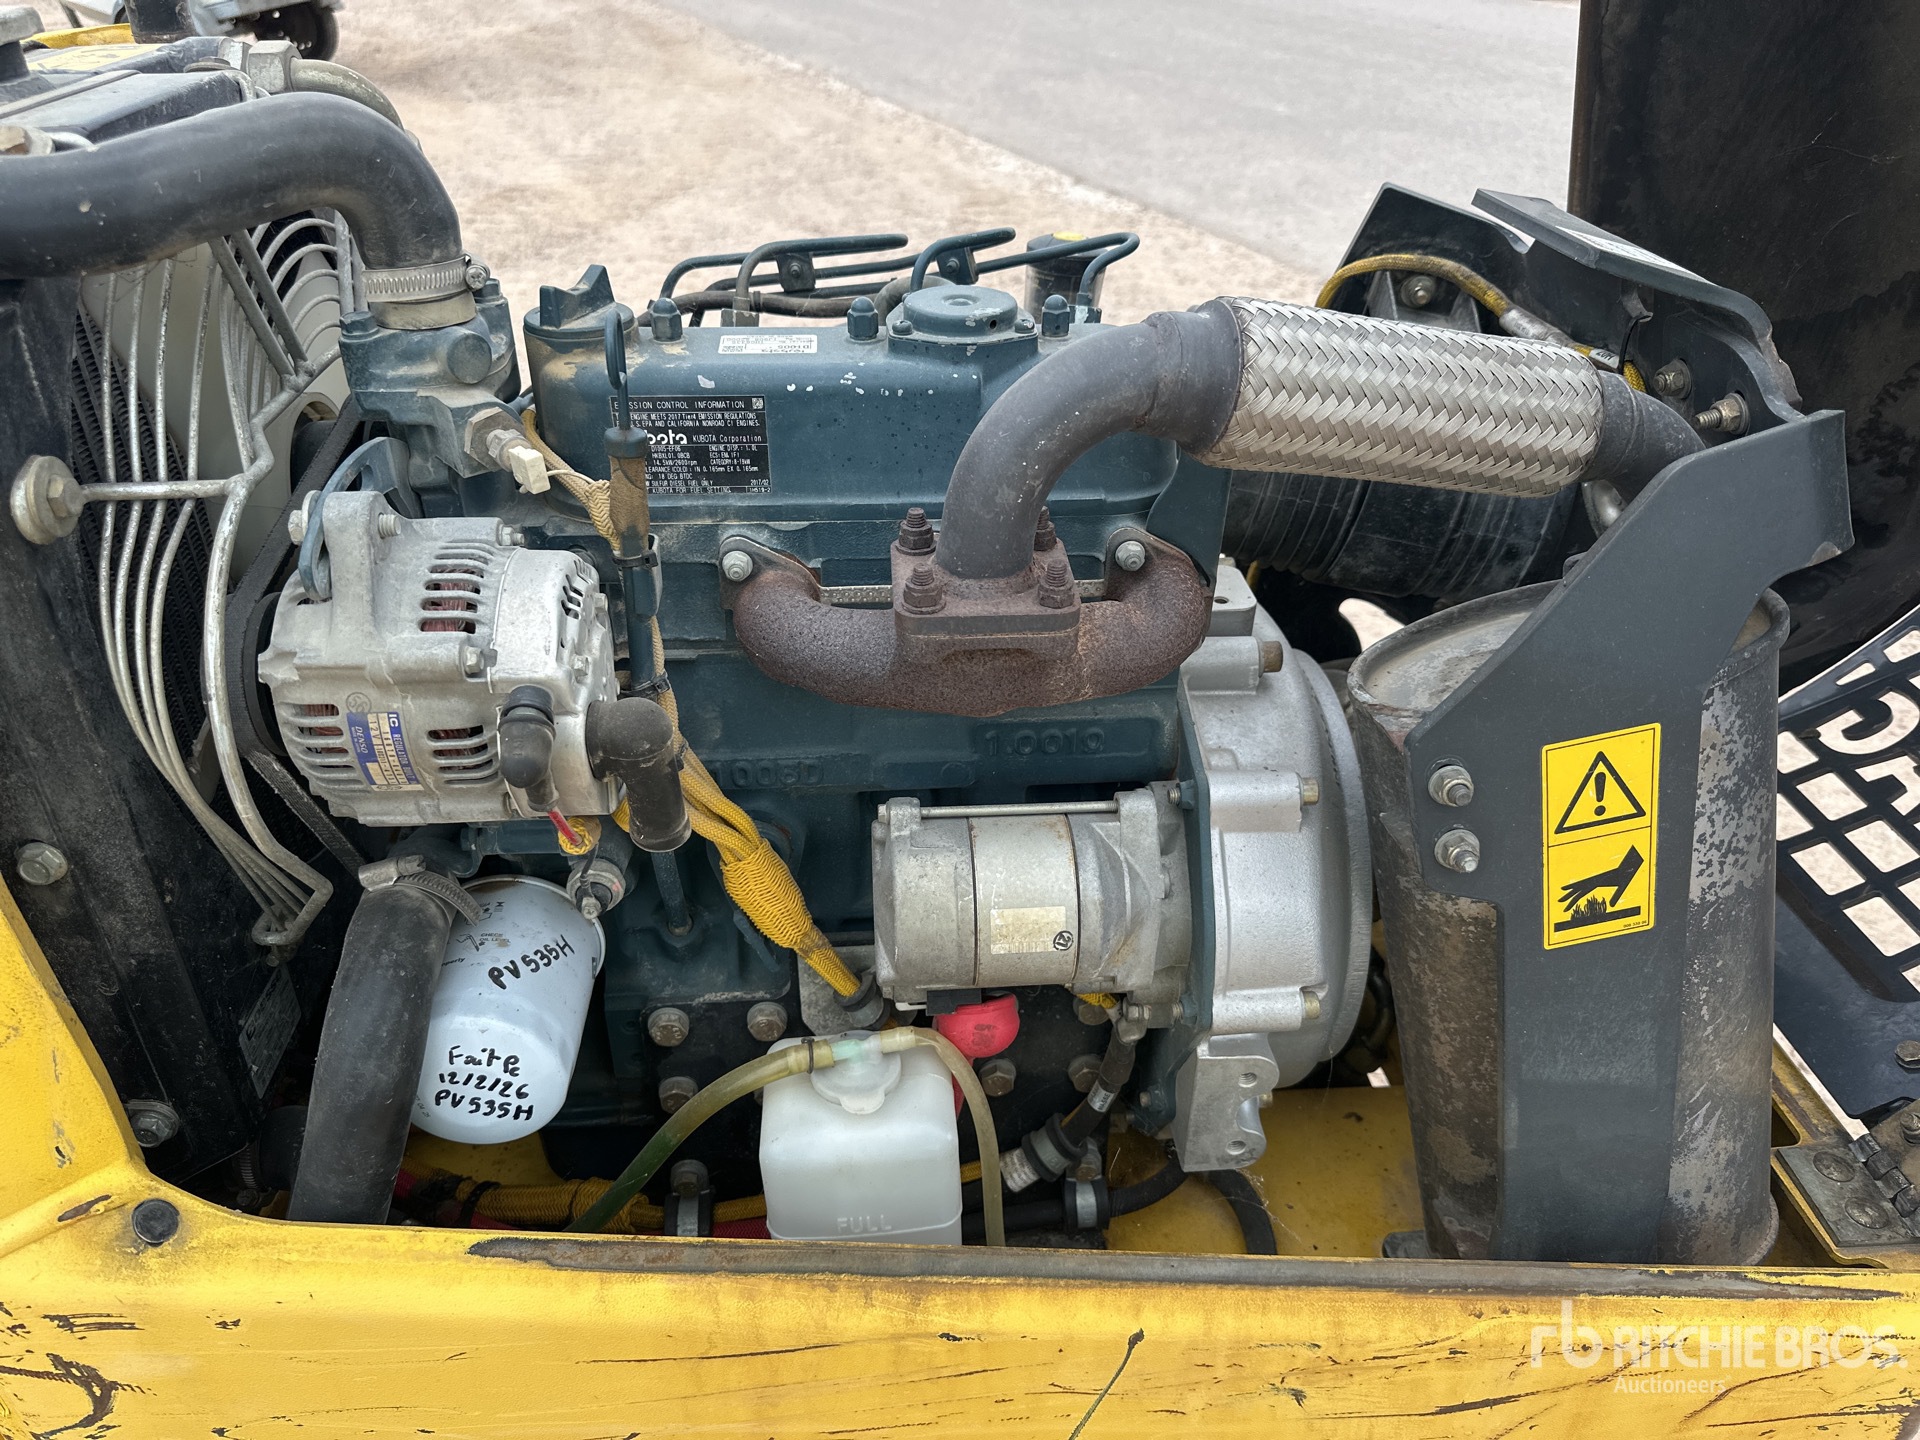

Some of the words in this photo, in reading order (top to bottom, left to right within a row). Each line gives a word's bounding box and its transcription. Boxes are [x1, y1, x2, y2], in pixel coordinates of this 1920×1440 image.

[614, 401, 653, 409] ESSION
[656, 401, 689, 409] CONTROL
[695, 400, 745, 409] INFORMATION
[698, 412, 723, 420] EMISSION
[724, 412, 757, 420] REGULATIONS
[645, 430, 687, 444] bota
[692, 435, 717, 443] KUBOTA
[720, 434, 762, 443] Corporation
[369, 721, 381, 740] 12V
[389, 714, 399, 727] IC
[355, 725, 369, 754] DENSO
[393, 733, 409, 765] REGULATOR
[402, 766, 416, 779] BUILT
[488, 959, 521, 990] PV
[521, 934, 575, 973] 535H
[438, 1071, 530, 1100] 12/2/26
[434, 1089, 466, 1109] PV
[468, 1096, 534, 1121] 535H
[836, 1213, 893, 1234] FULL
